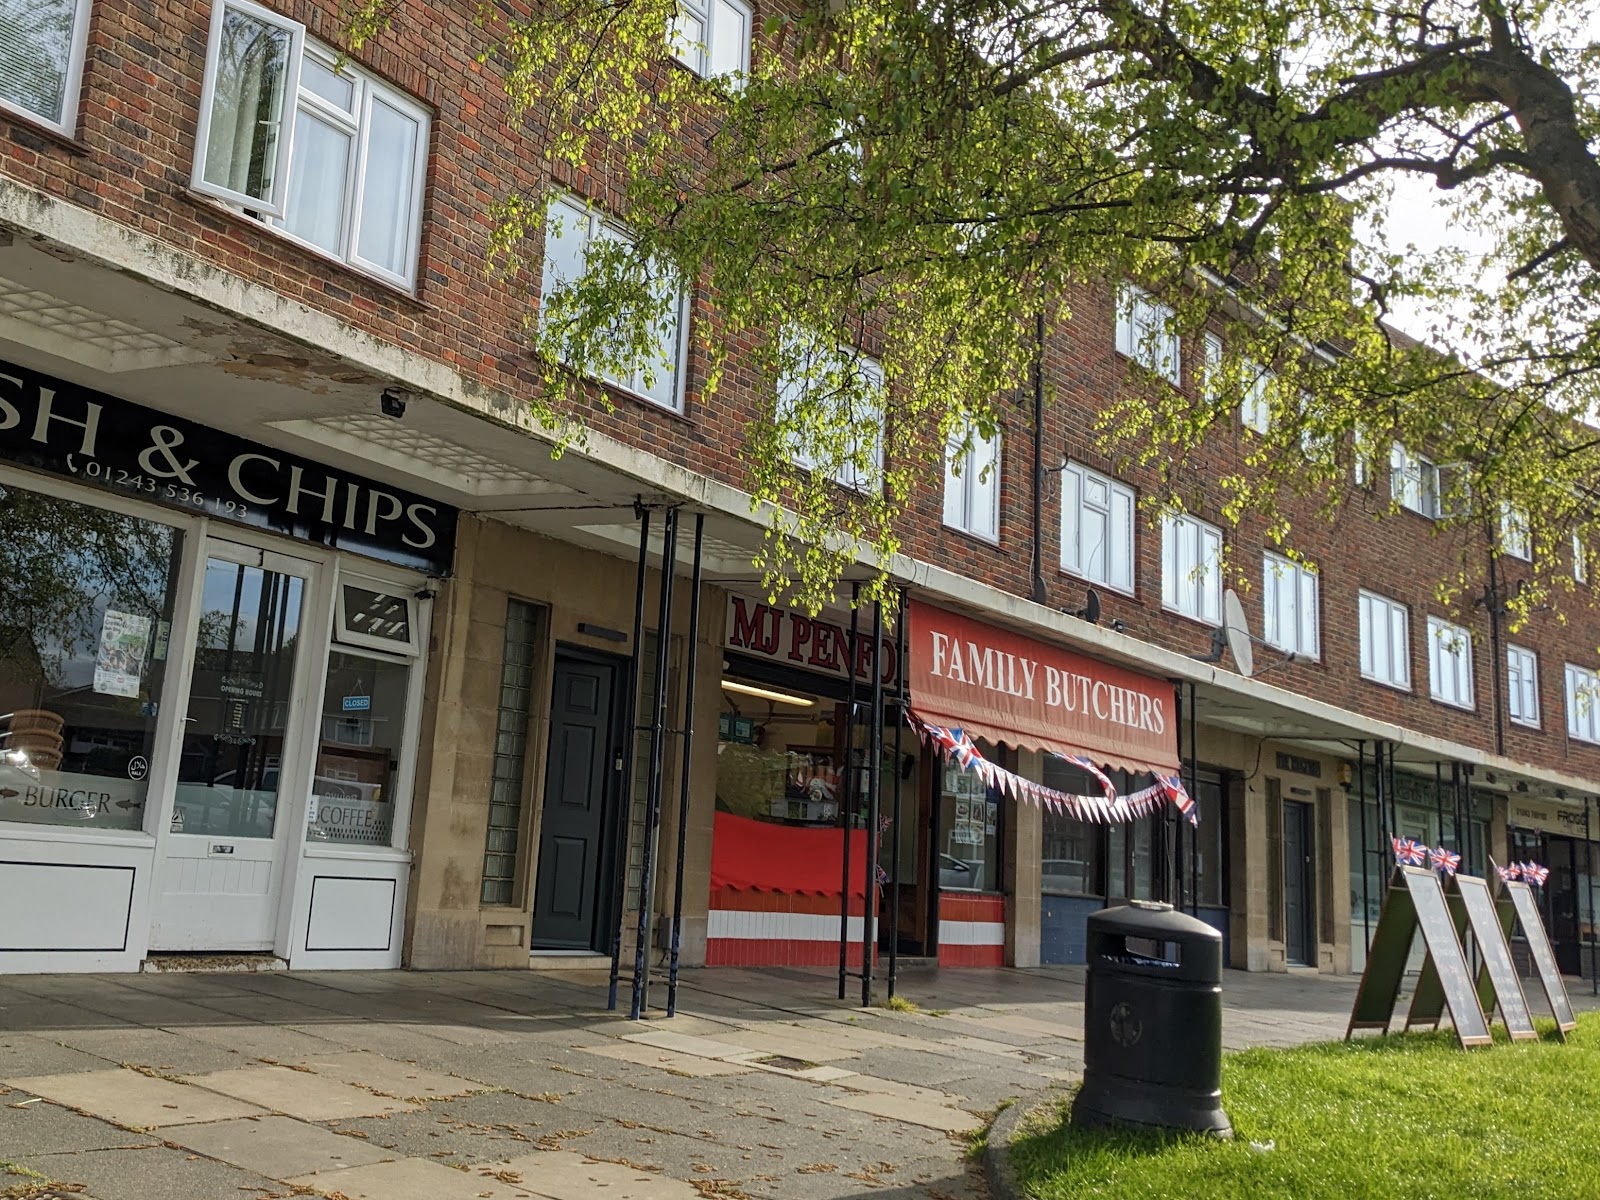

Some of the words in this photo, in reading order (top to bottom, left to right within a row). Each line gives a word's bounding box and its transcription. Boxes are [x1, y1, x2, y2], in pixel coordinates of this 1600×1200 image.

[86, 461, 156, 492] 01243
[165, 483, 204, 505] 536
[215, 497, 248, 518] 193
[138, 425, 200, 487] &
[227, 453, 437, 549] CHIPS
[729, 595, 784, 655] MJ
[344, 699, 369, 707] CLOSED
[930, 631, 1038, 700] FAMILY
[1043, 665, 1165, 735] BUTCHERS
[24, 785, 111, 813] BURGER
[320, 805, 373, 828] COFFEE
